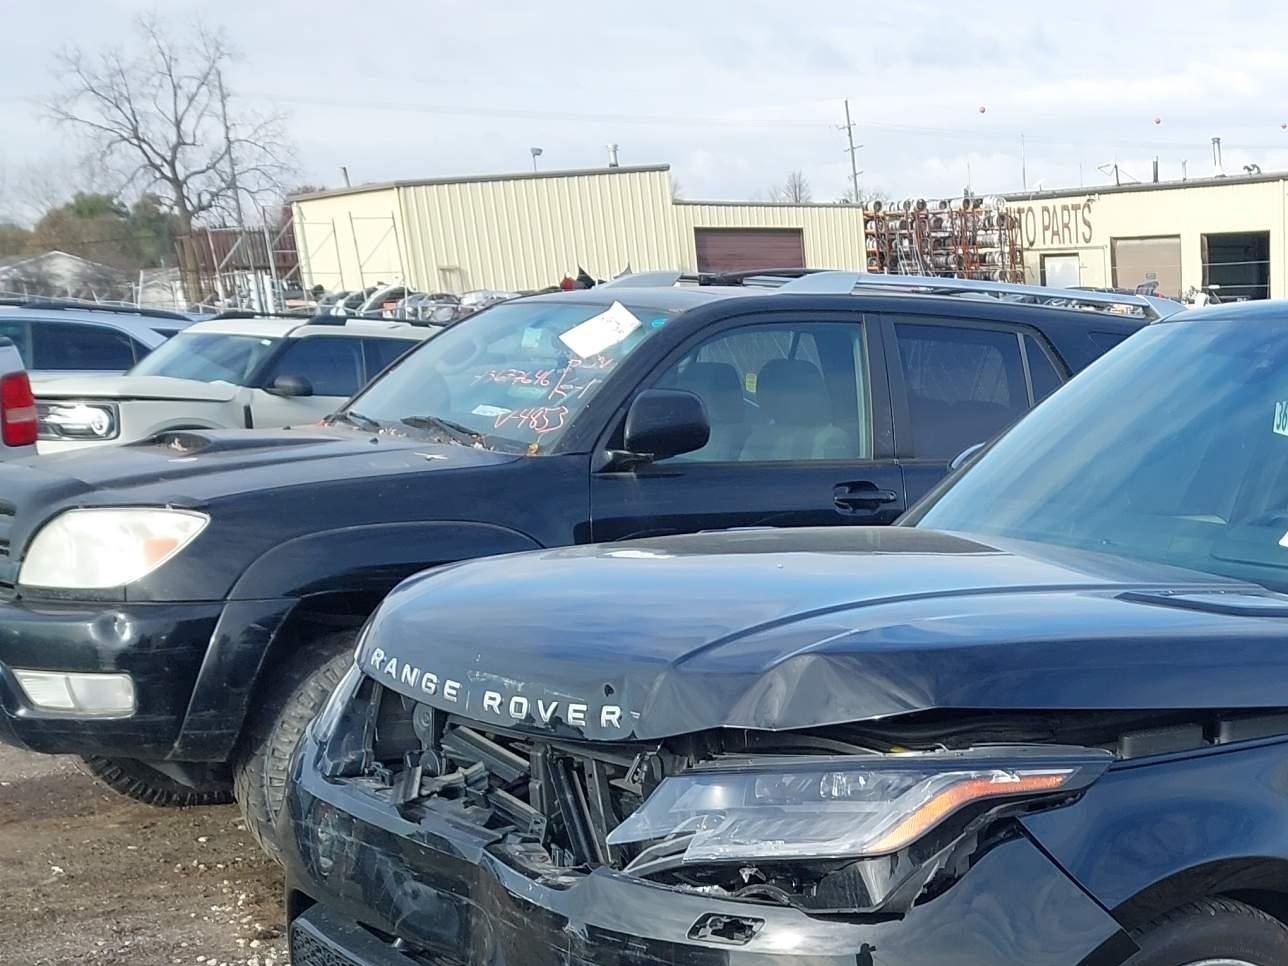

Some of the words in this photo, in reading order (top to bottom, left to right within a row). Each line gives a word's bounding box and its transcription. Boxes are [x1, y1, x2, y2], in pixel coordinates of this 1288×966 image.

[1041, 203, 1093, 245] PARTS
[370, 647, 461, 702] RANGE
[483, 690, 622, 729] ROVER
